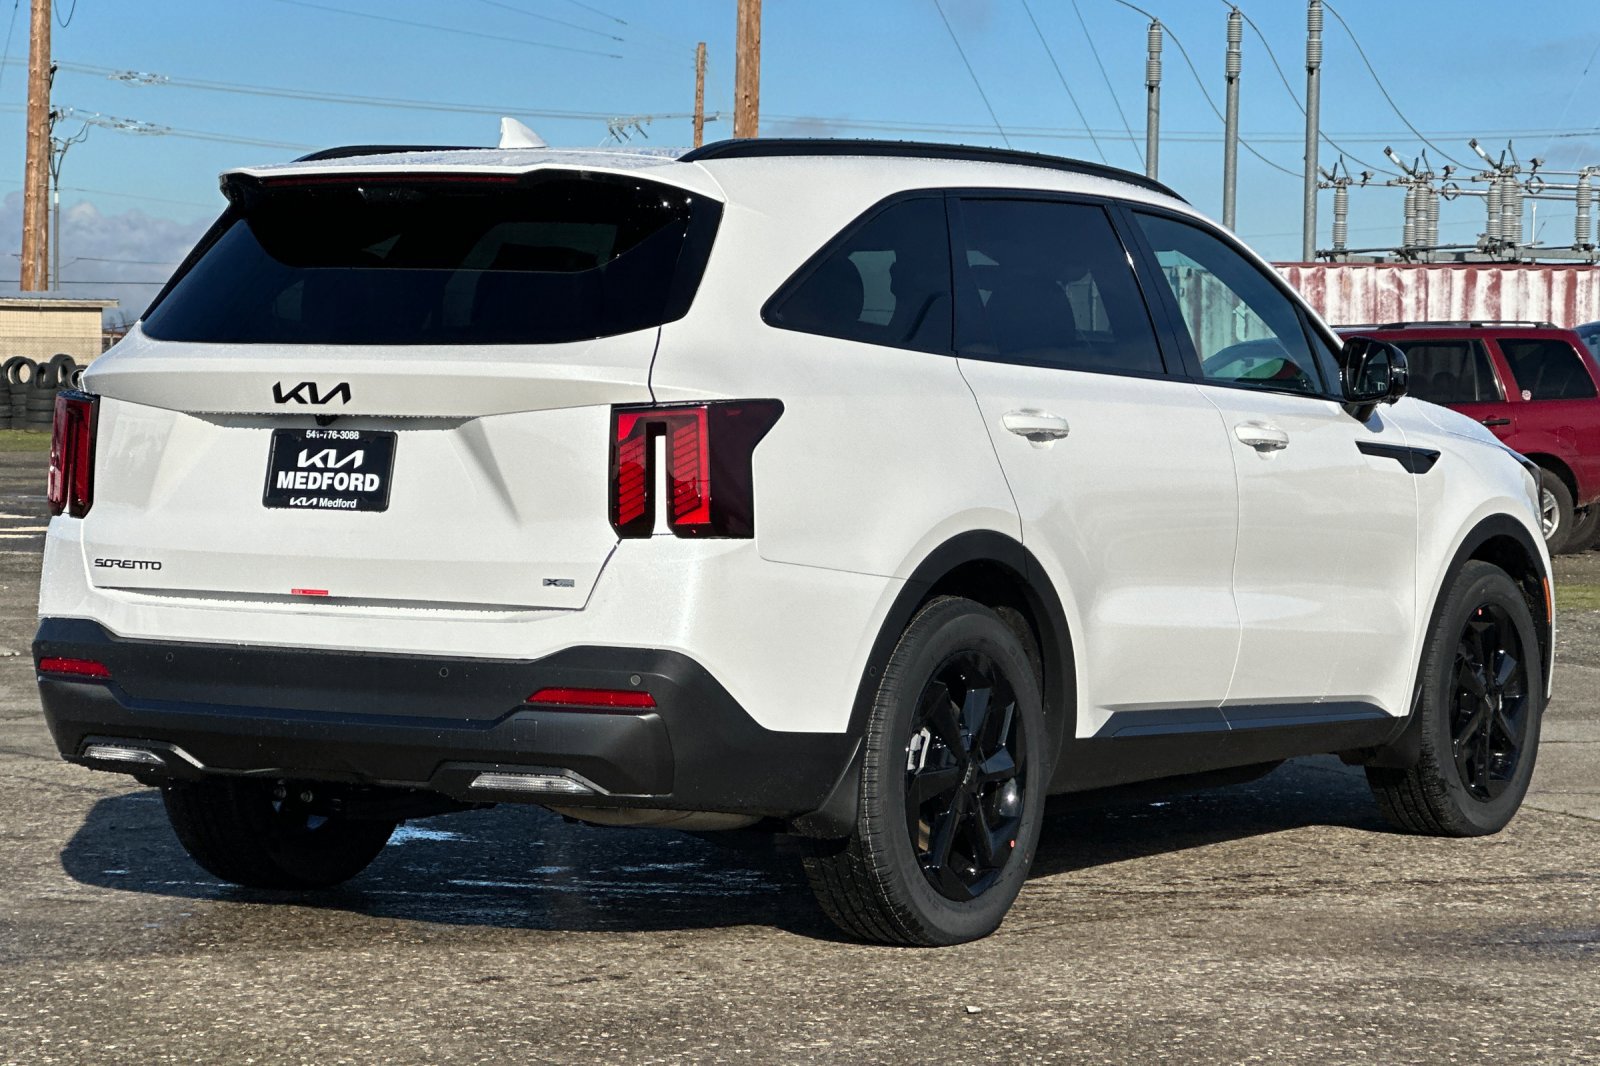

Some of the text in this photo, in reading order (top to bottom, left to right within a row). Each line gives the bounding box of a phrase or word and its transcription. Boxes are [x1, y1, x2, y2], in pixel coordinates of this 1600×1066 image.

[272, 381, 351, 405] KIA
[297, 448, 365, 469] KIA
[276, 471, 380, 492] MEDFORD
[319, 497, 358, 509] Medford
[94, 558, 162, 571] SORENTO
